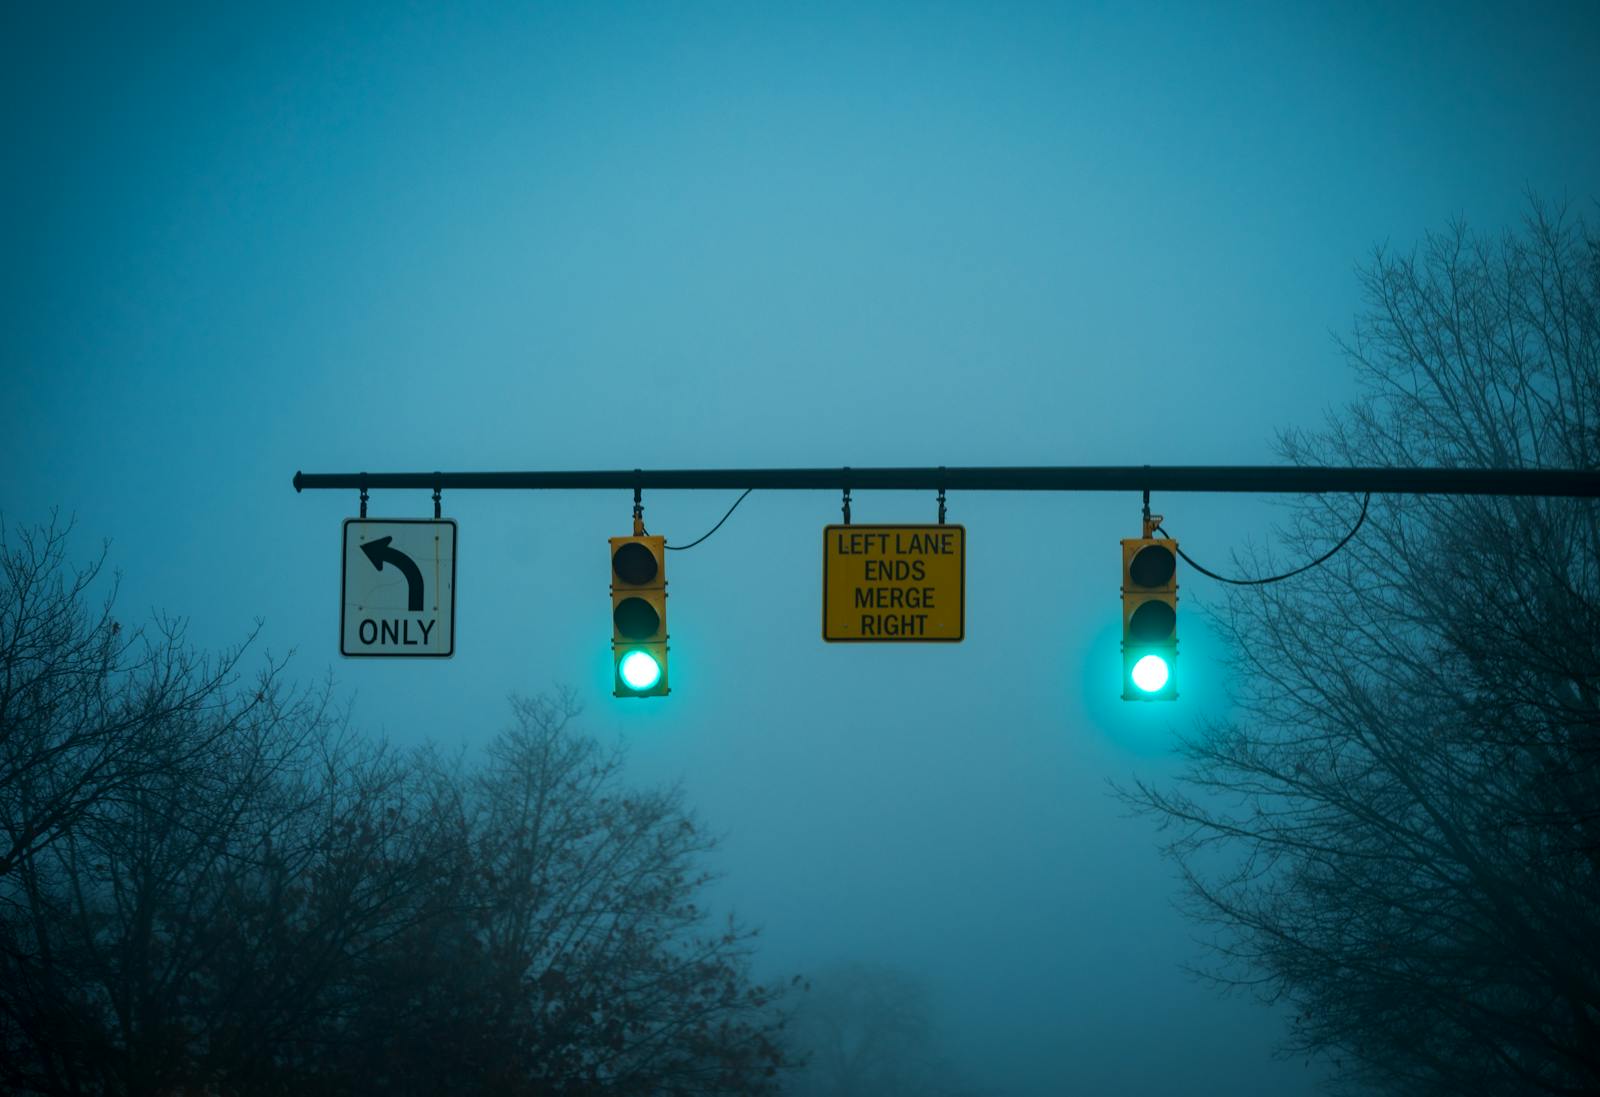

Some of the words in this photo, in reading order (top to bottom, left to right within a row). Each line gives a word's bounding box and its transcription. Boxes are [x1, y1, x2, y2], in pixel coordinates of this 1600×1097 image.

[838, 534, 890, 555] LEFT
[896, 534, 954, 555] LANE
[865, 560, 926, 581] ENDS
[855, 587, 935, 609] MERGE
[359, 618, 436, 646] ONLY
[861, 614, 928, 636] RIGHT
